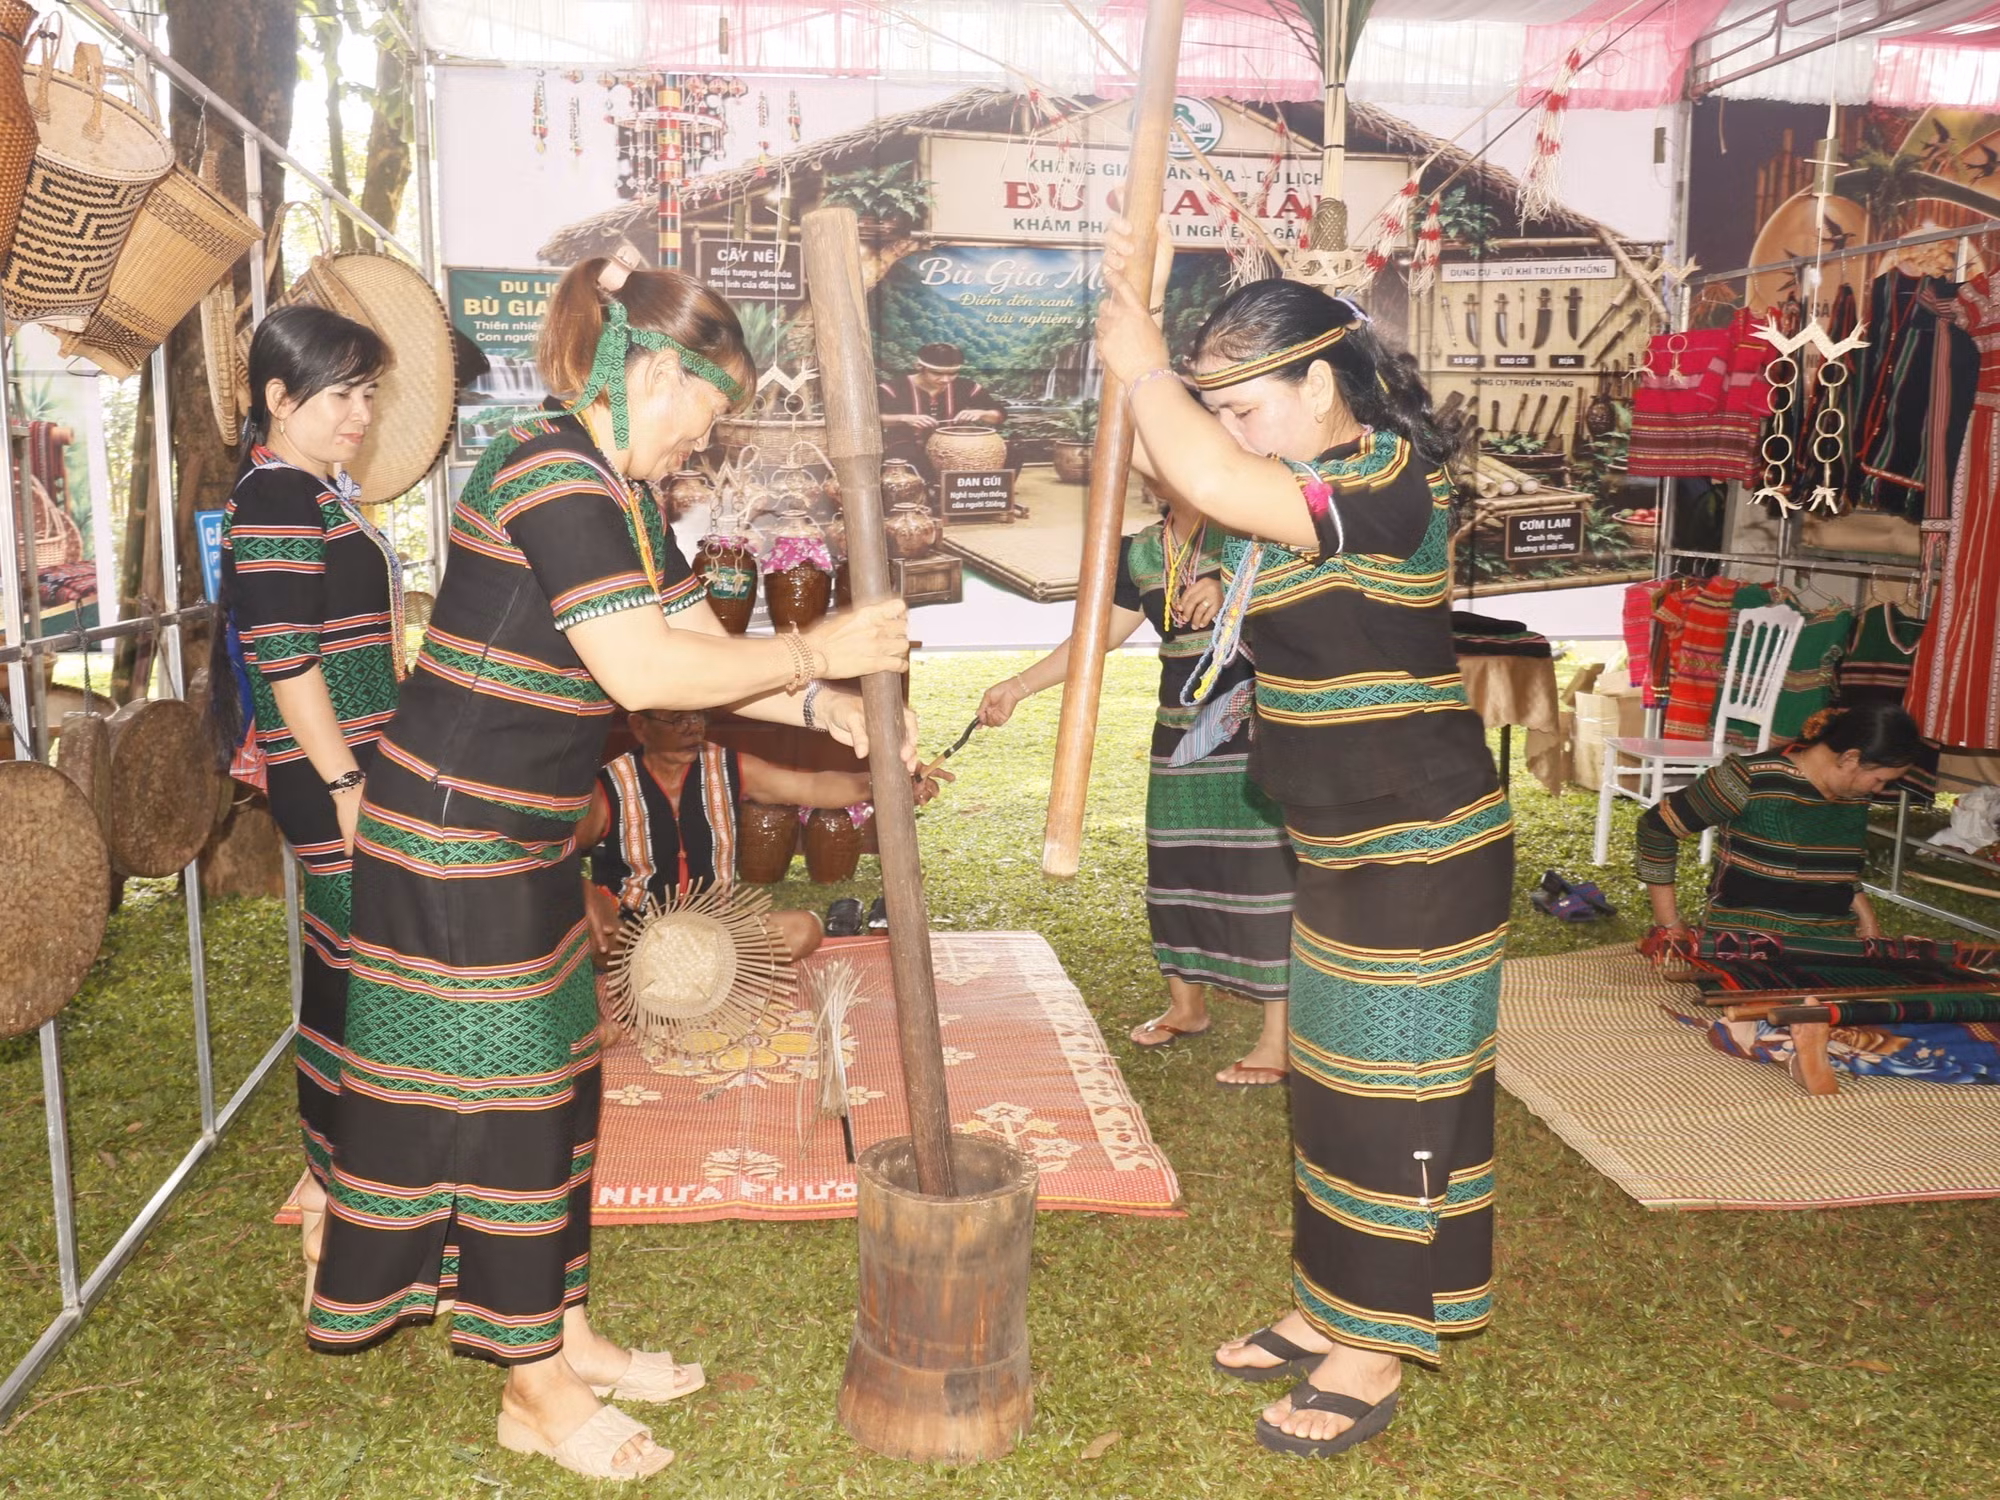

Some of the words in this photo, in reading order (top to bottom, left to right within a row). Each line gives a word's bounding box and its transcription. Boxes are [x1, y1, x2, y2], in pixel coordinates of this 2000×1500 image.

[1167, 164, 1192, 179] ĂN
[1013, 216, 1070, 232] KHÁM
[1078, 221, 1105, 232] PH
[717, 247, 748, 262] CÂY
[919, 257, 976, 286] Bù
[984, 259, 1049, 294] Gia
[500, 280, 528, 294] DU
[464, 296, 500, 316] BÙ
[959, 292, 1002, 306] Điểm
[1006, 294, 1034, 307] đến
[1036, 295, 1076, 308] xanh
[474, 320, 509, 330] Thiên
[476, 333, 501, 342] Con
[957, 478, 980, 487] ĐAN
[1519, 519, 1545, 530] CƠM
[1548, 518, 1571, 529] LAM
